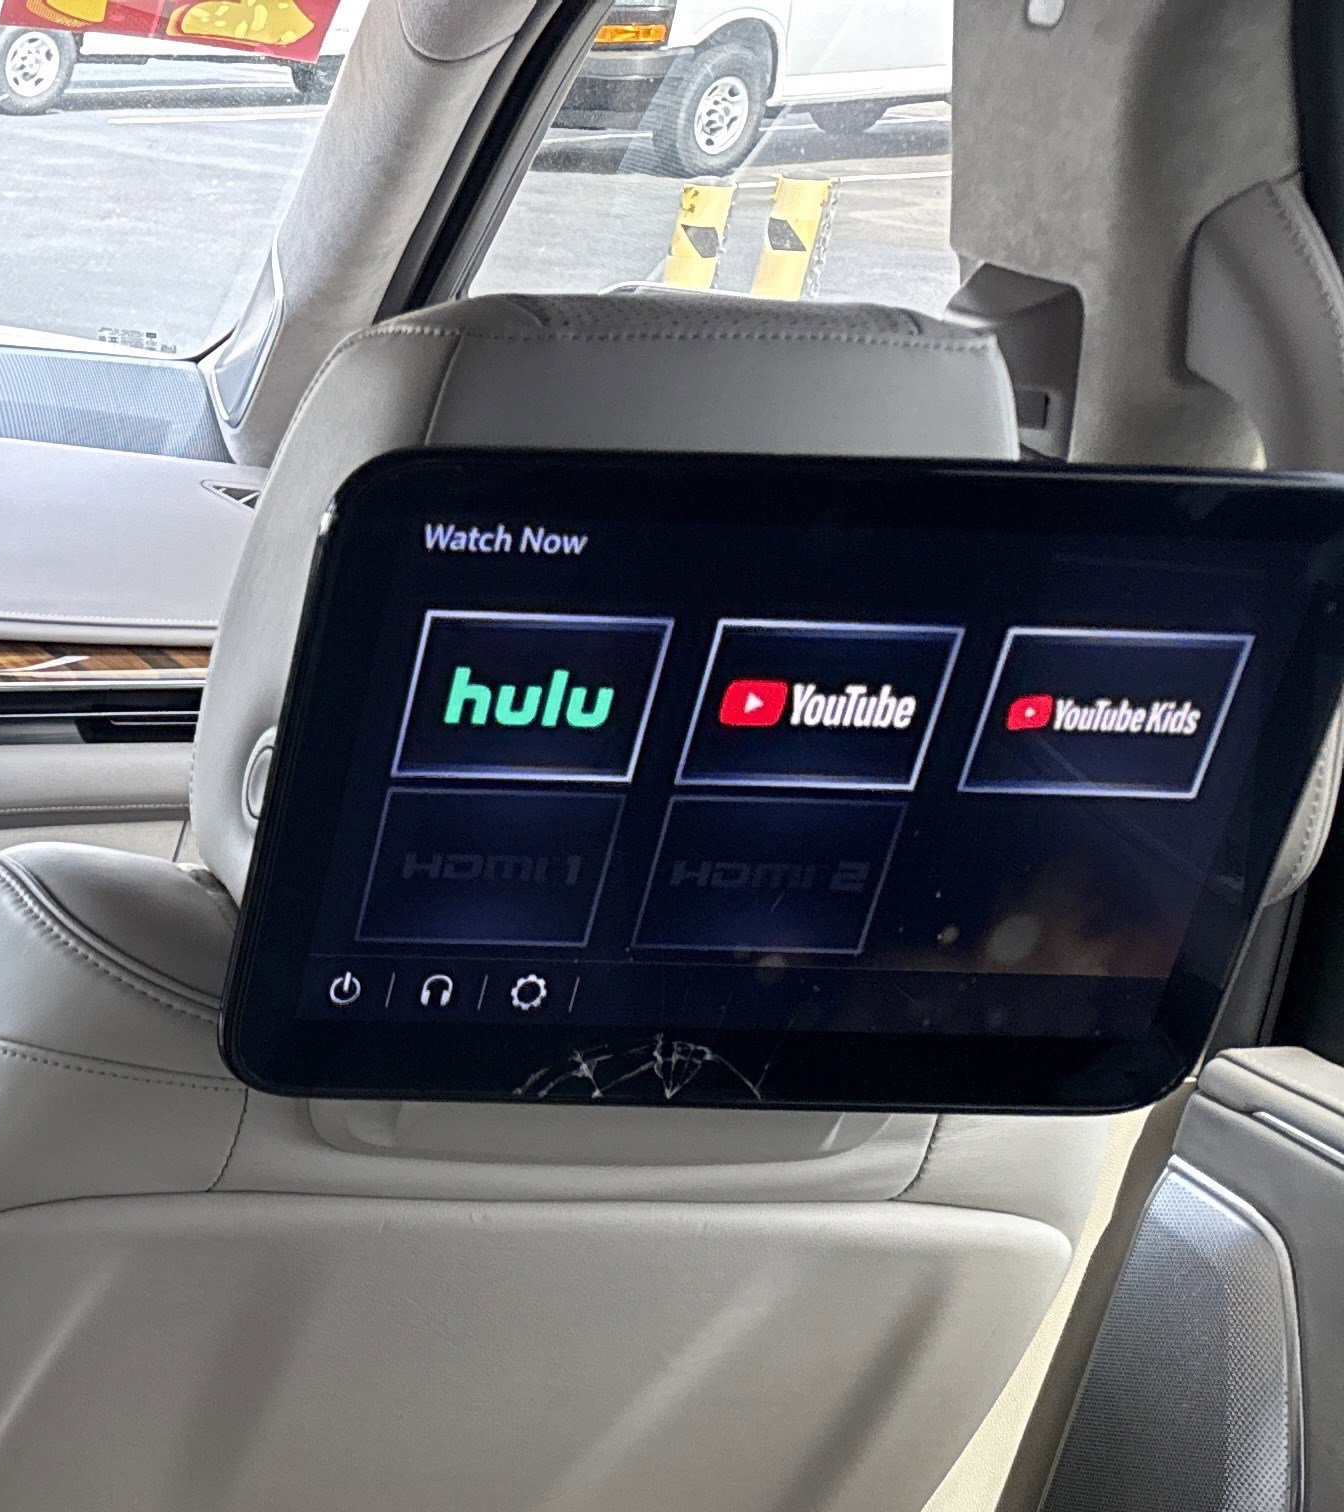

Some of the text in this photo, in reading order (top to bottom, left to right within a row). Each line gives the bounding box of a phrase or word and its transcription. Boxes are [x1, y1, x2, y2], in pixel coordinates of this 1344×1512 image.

[425, 523, 588, 555] Watch Now
[443, 666, 615, 728] hulu
[789, 683, 917, 730] YouTube
[1053, 697, 1201, 736] YouTube Kids
[400, 851, 584, 886] HDMI 1
[669, 860, 871, 893] HDMI 2
